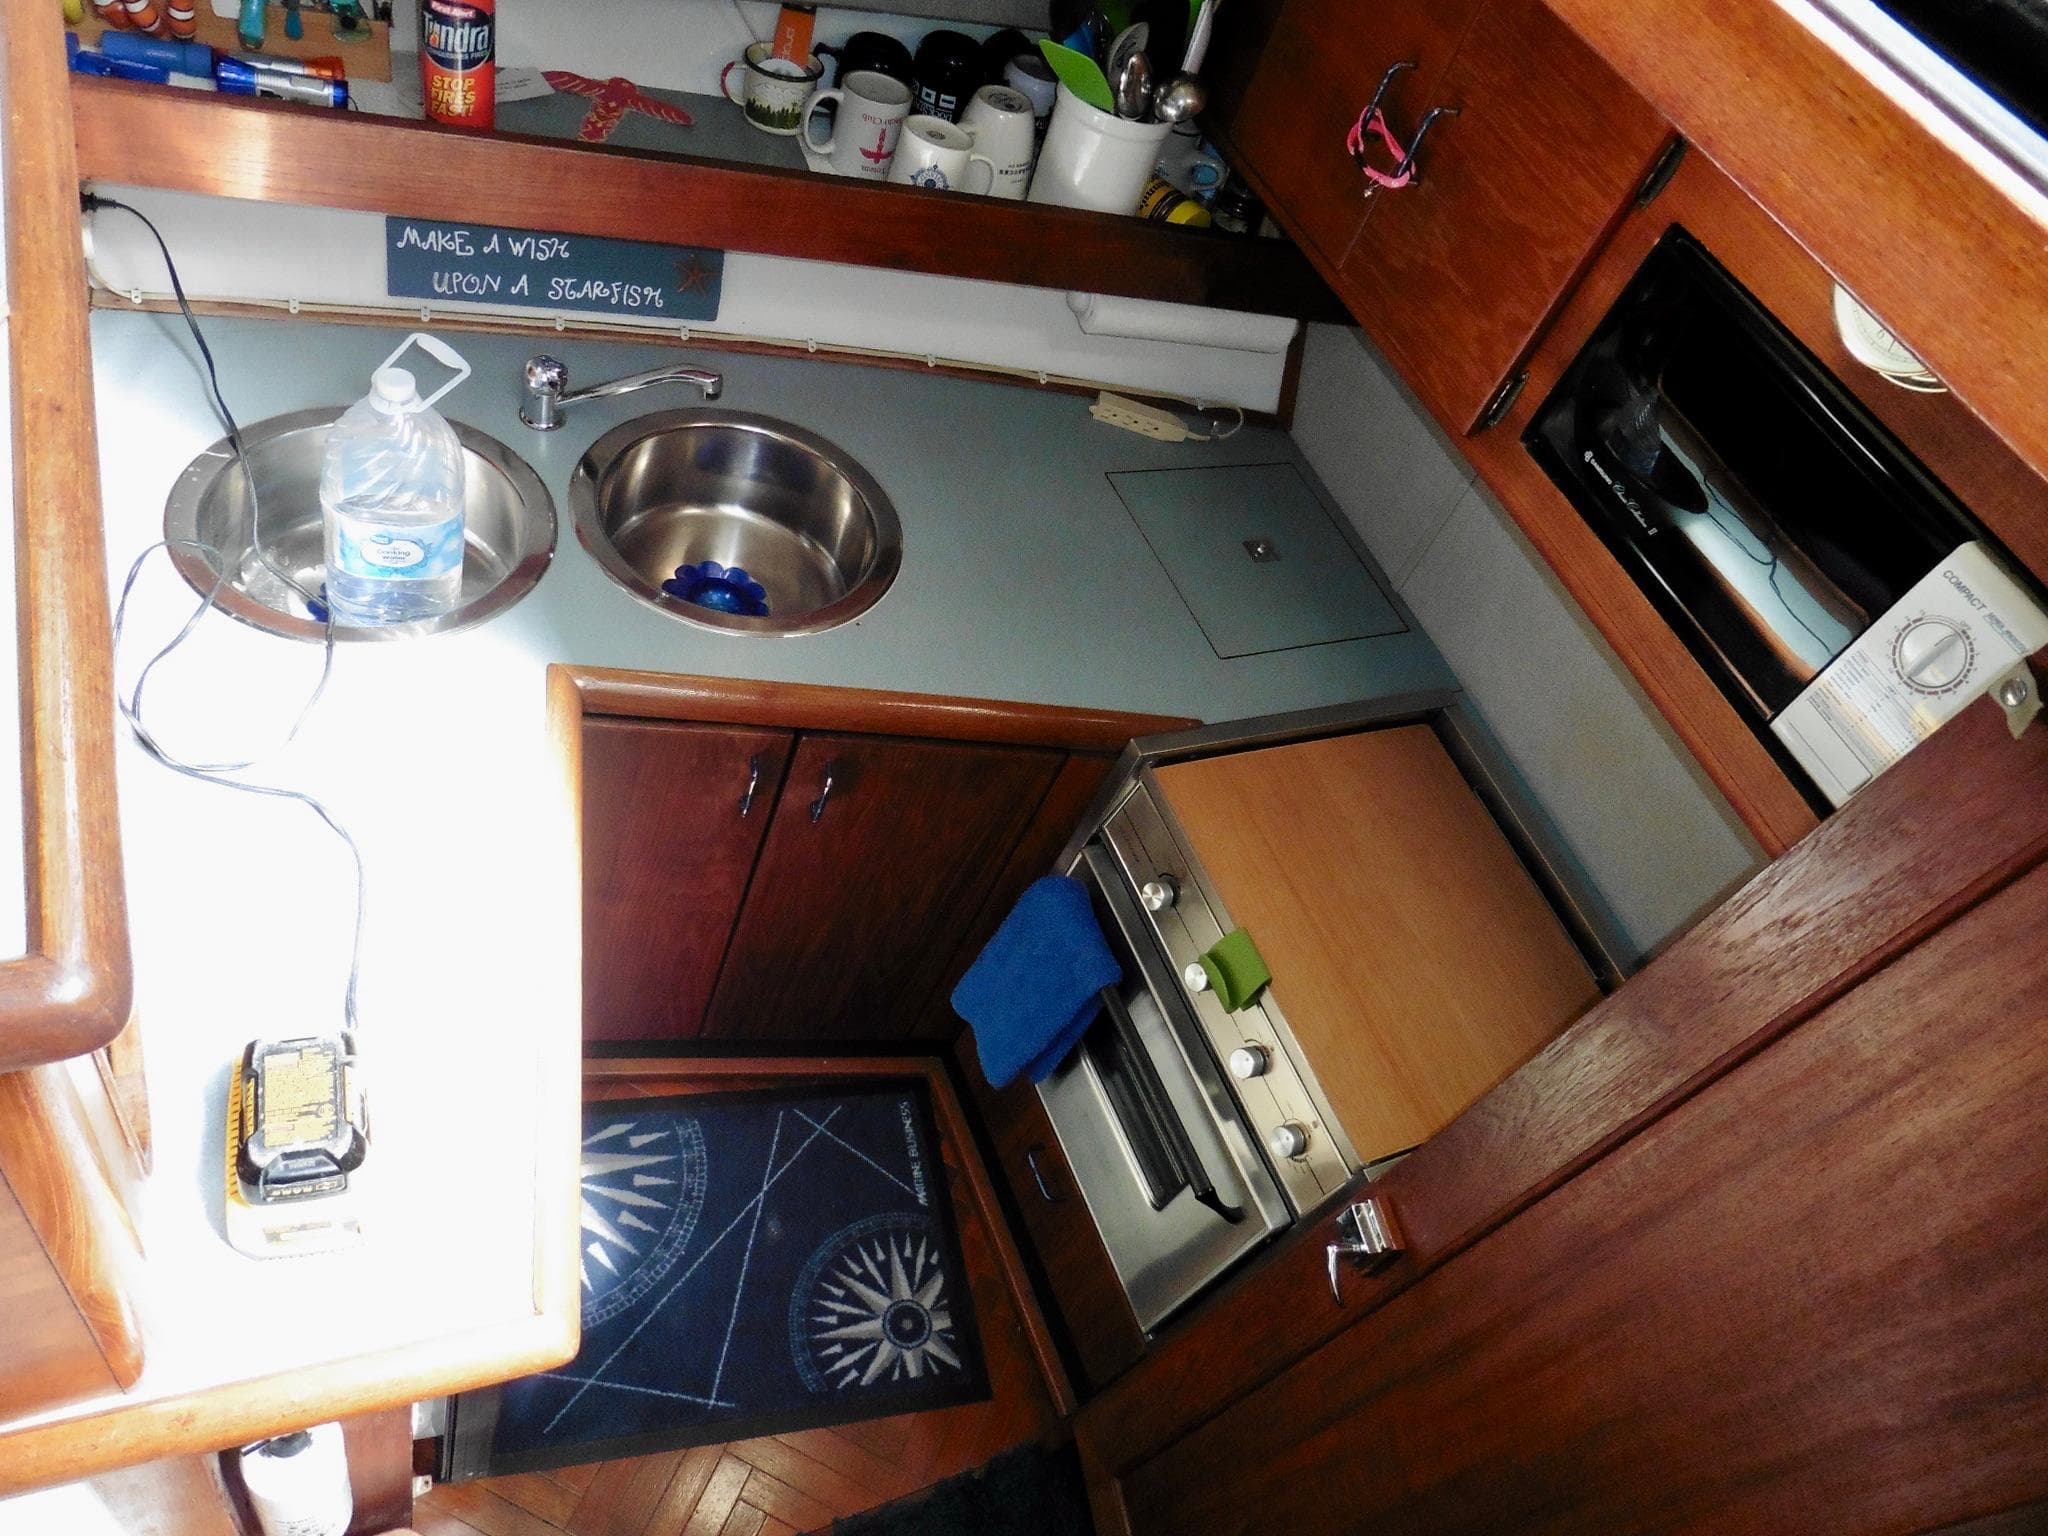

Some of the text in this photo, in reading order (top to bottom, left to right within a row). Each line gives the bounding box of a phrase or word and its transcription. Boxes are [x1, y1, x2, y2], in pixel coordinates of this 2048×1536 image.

[423, 11, 489, 53] Tundra
[431, 87, 476, 104] FIRES
[432, 75, 476, 91] STOP
[862, 113, 882, 126] Club
[397, 226, 570, 261] MAKE A WISH
[433, 271, 664, 308] UPON A STARFISH
[1943, 570, 1988, 611] COMPACT
